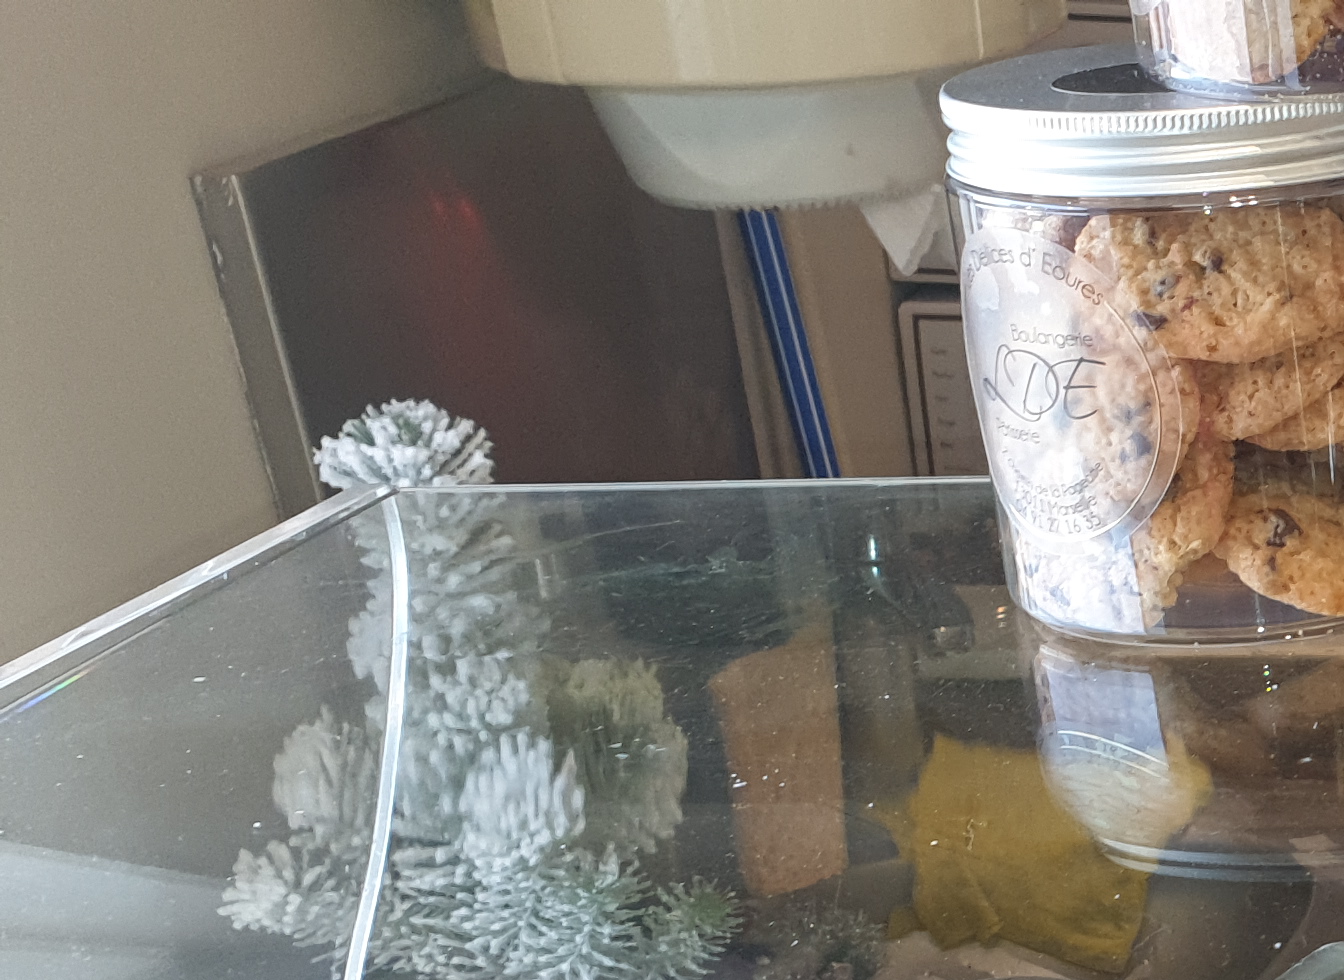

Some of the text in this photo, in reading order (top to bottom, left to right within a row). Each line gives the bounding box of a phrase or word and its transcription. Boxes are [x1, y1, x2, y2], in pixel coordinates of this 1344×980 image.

[1041, 252, 1104, 305] Eoures
[1010, 324, 1094, 348] Boulangerie
[1065, 518, 1082, 534] 16
[1082, 511, 1102, 530] 35
